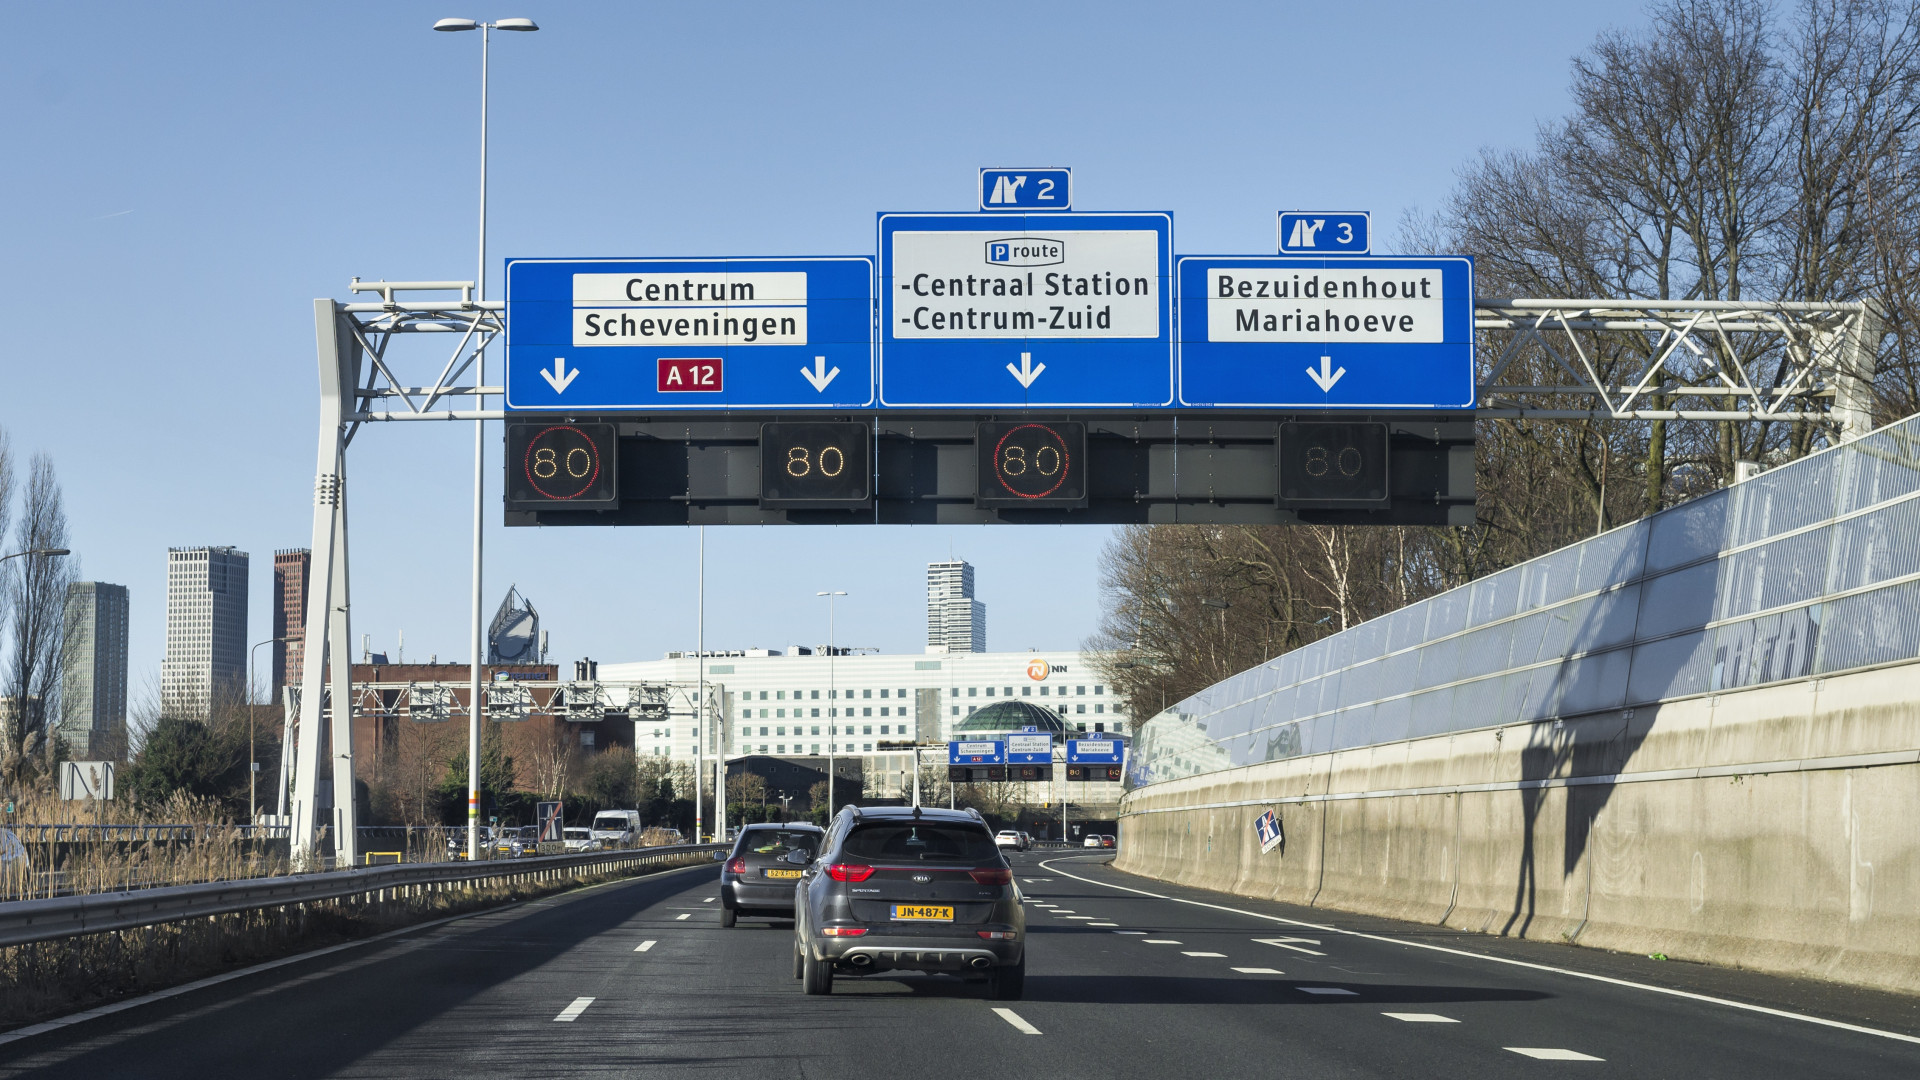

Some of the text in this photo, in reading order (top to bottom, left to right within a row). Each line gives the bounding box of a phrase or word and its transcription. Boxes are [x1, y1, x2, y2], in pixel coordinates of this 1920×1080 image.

[1037, 178, 1055, 200] 2
[1336, 222, 1354, 244] 3
[994, 244, 1059, 260] P route
[626, 278, 755, 302] Centrum
[1045, 271, 1149, 296] Station
[1218, 274, 1432, 298] Bezuidenhout
[584, 312, 797, 342] Scheveningen
[1235, 308, 1415, 332] Mariahoeve
[666, 365, 715, 386] A 12
[534, 447, 591, 479] 80
[787, 446, 845, 477] 80
[1003, 445, 1060, 476] 80
[1305, 446, 1363, 477] 80
[1051, 665, 1067, 673] NN
[900, 907, 950, 918] JN-487-K
